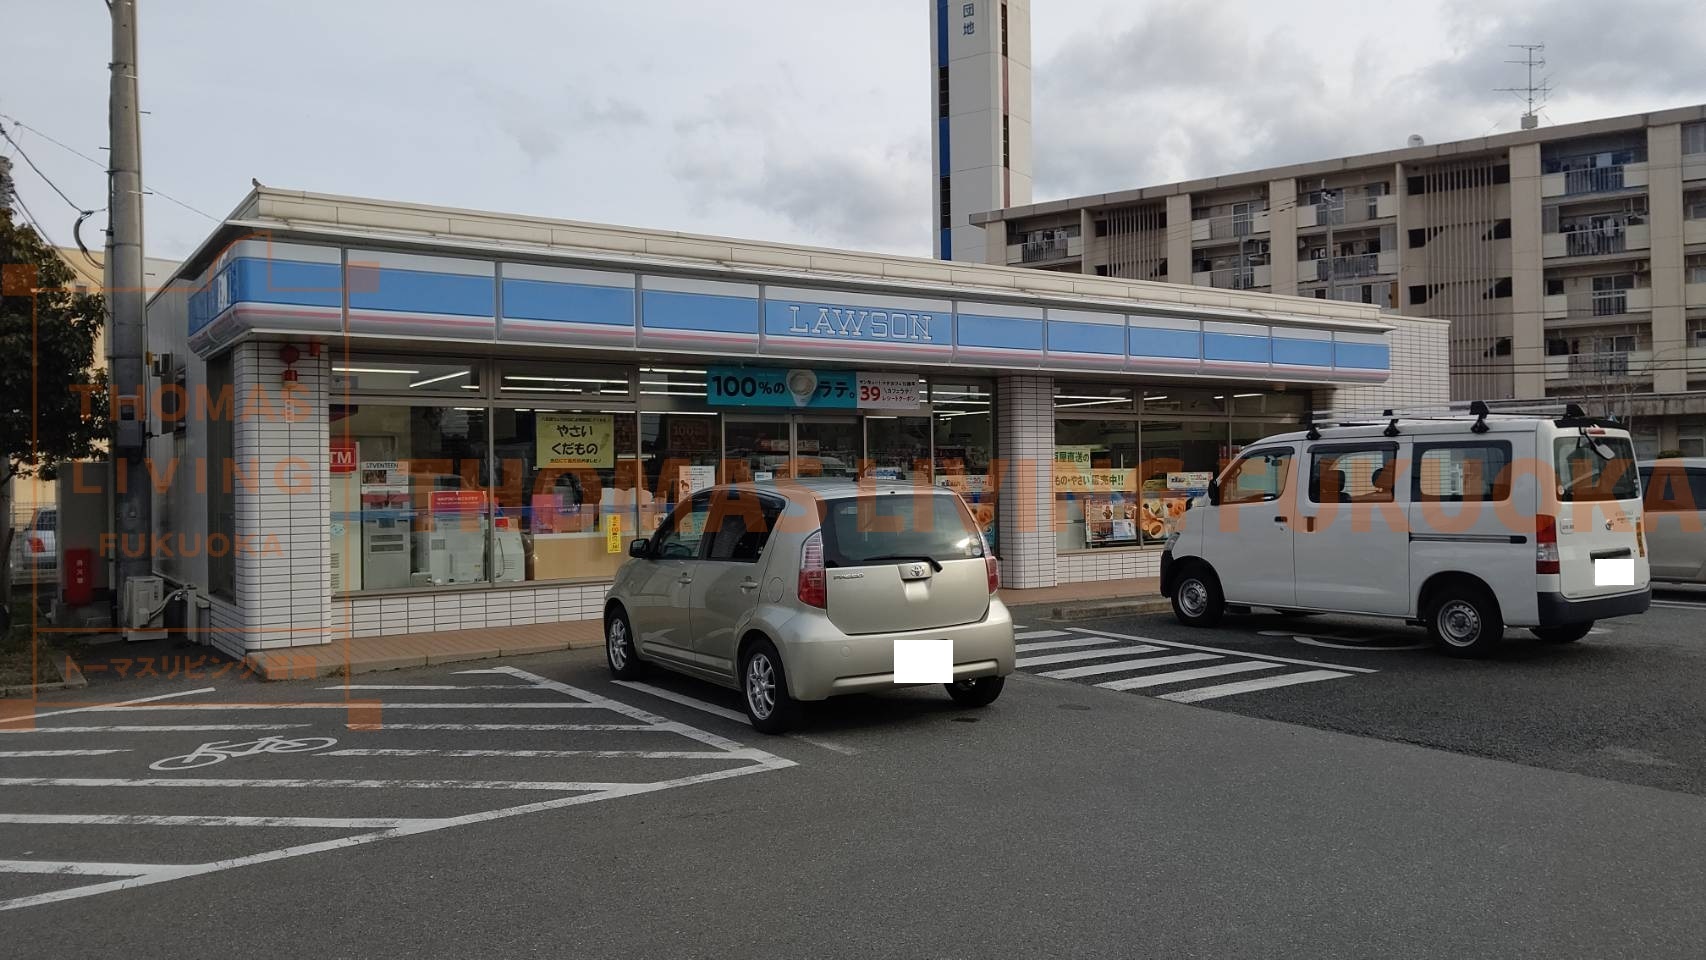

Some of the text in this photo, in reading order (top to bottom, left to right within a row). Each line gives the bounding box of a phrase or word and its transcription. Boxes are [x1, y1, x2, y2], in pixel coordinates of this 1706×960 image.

[962, 3, 975, 36] 団地
[789, 306, 932, 340] LAWSON
[712, 375, 785, 397] 100%の
[860, 386, 881, 401] 39
[557, 425, 593, 437] やさい
[551, 442, 598, 455] くだもの
